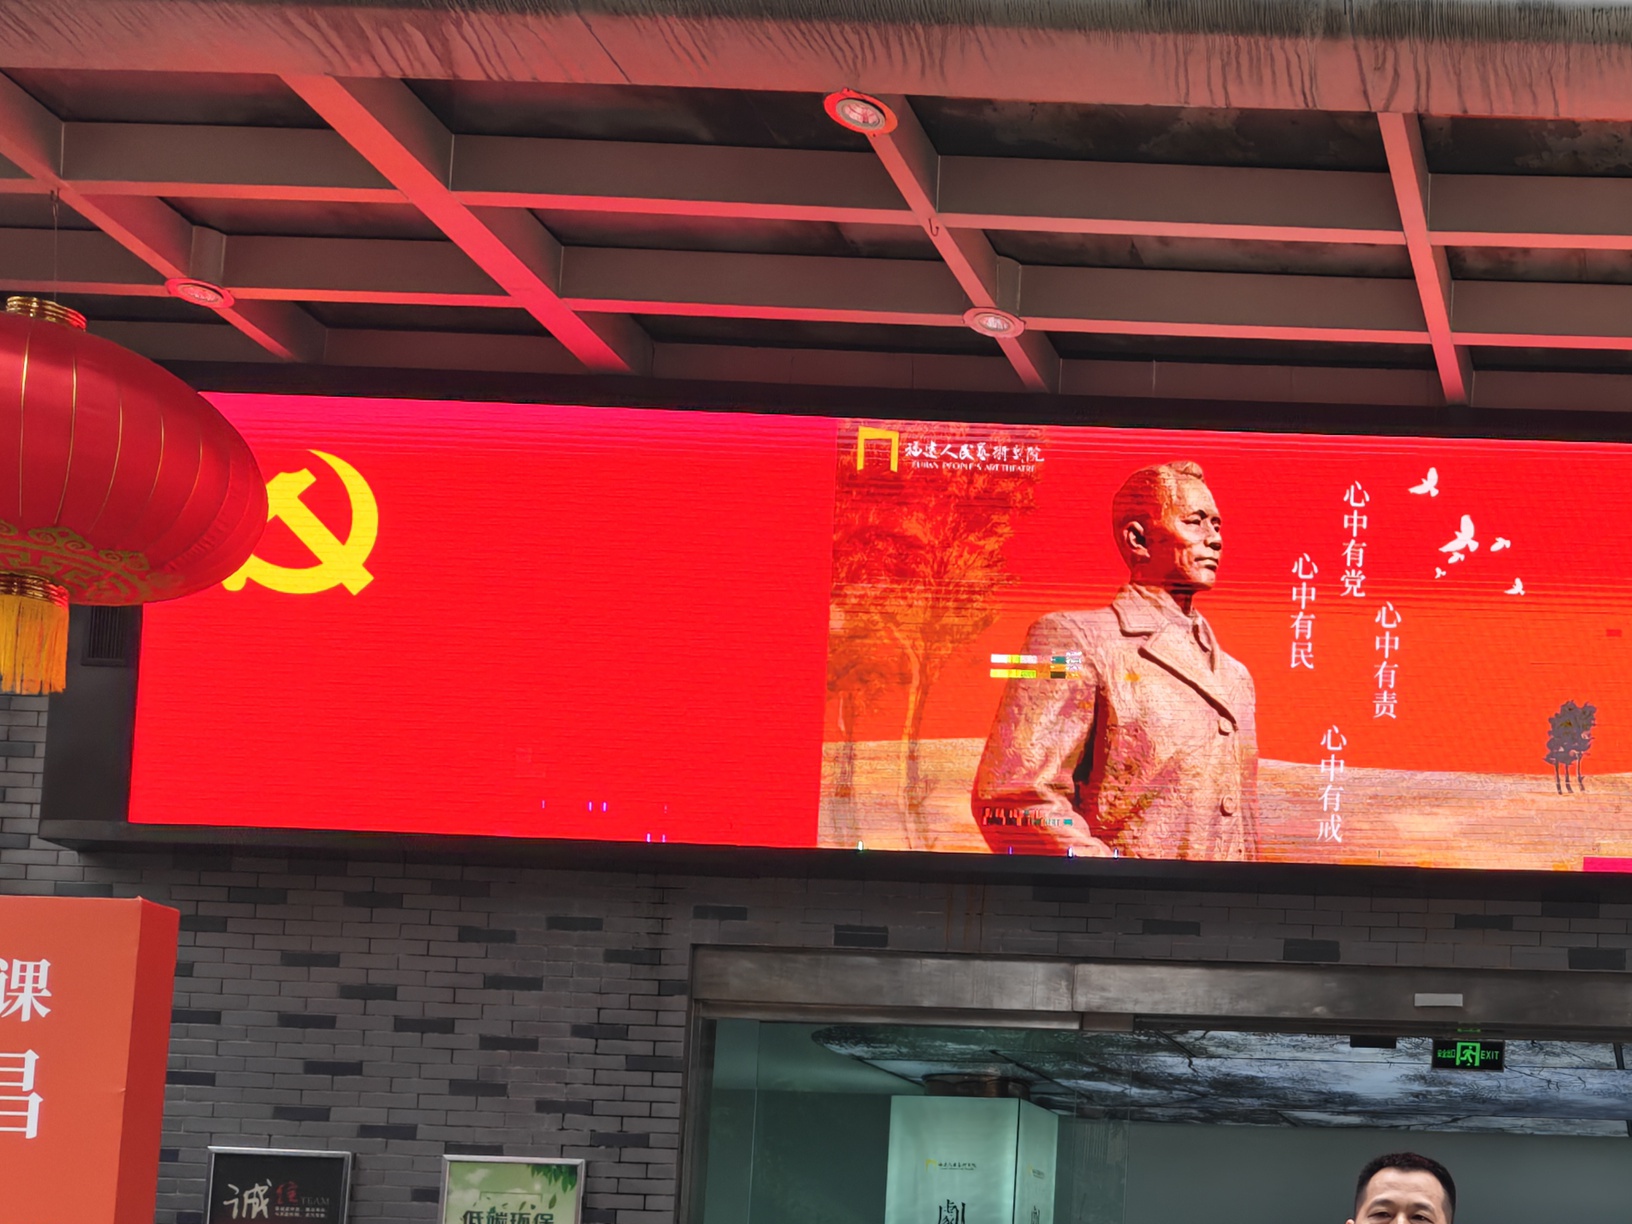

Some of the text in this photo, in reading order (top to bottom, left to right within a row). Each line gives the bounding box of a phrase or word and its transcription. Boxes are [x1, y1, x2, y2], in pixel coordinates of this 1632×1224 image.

[1340, 480, 1370, 598] 心中有党
[1289, 552, 1319, 670] 心中有民
[1372, 601, 1402, 720] 心中有责
[1316, 724, 1347, 843] 心中有戒
[1480, 1050, 1500, 1060] EXIT
